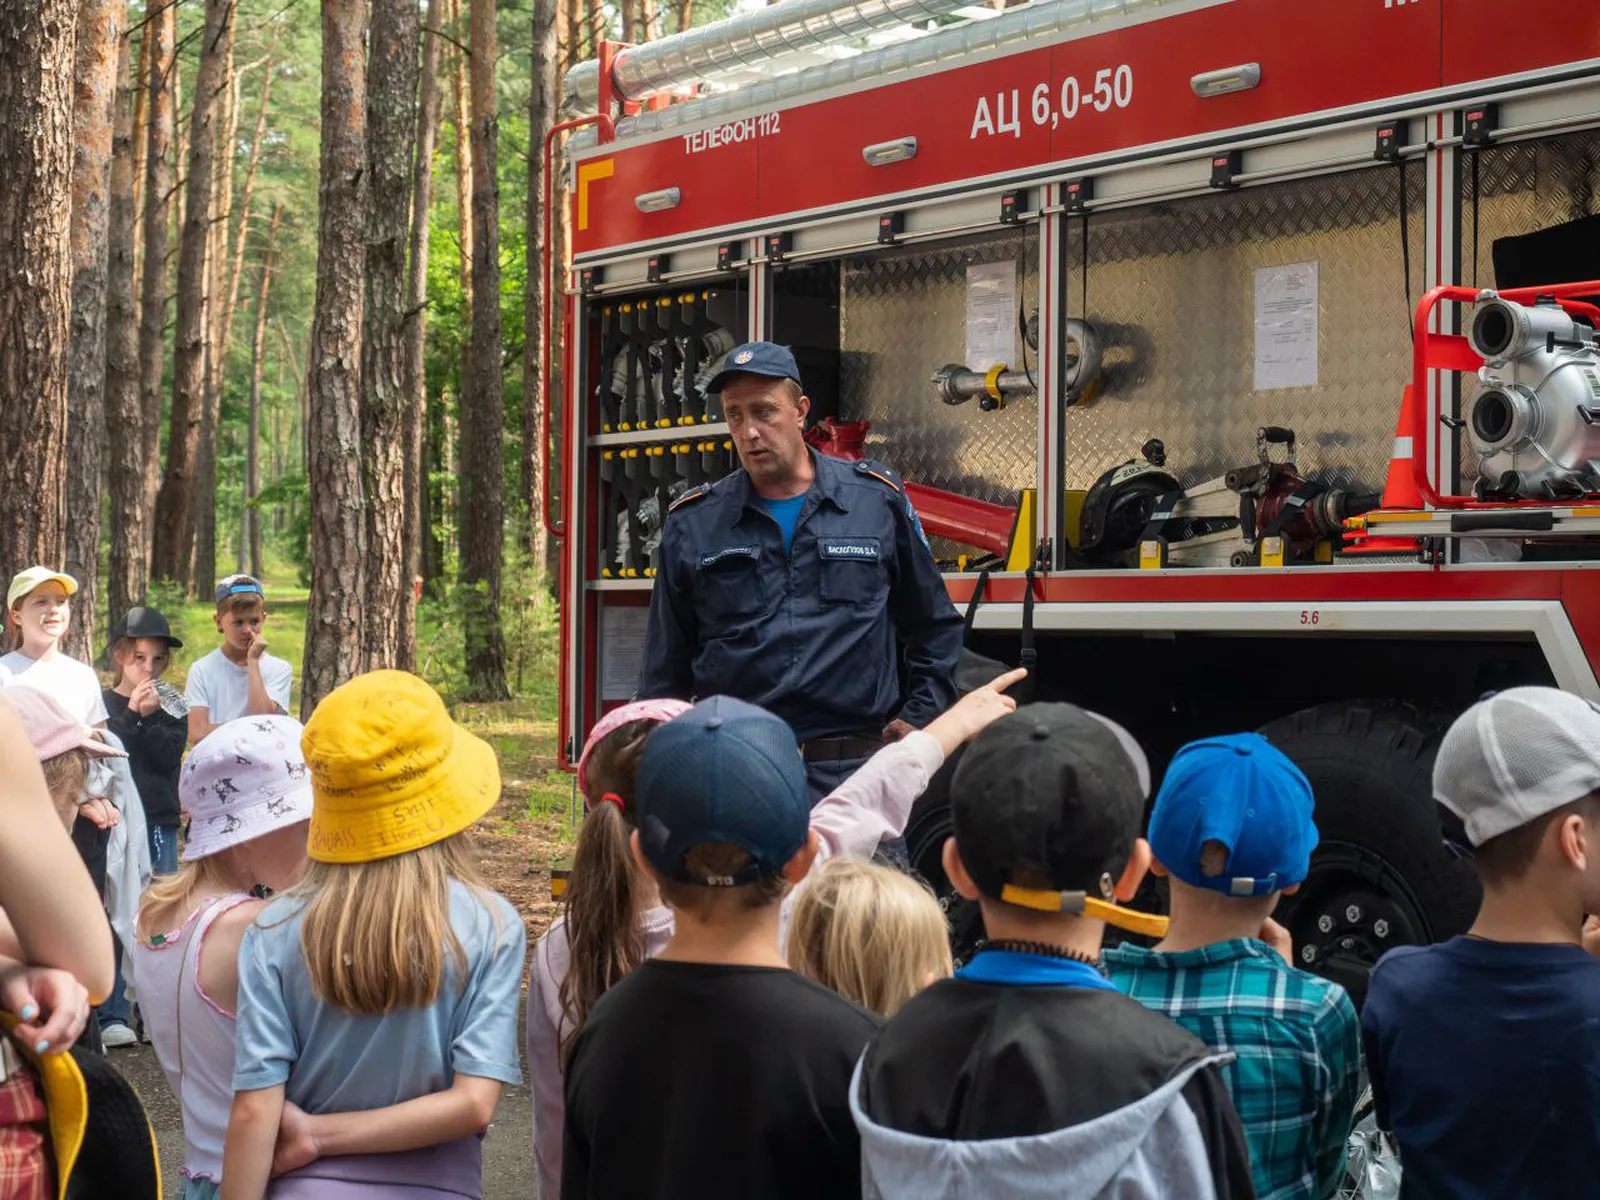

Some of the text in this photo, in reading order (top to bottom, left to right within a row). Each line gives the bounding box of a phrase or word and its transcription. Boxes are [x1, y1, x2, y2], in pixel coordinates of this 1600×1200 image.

[970, 64, 1133, 139] АЦ 6,0-50
[683, 112, 780, 154] ТЕЛЕФОН 112
[1300, 610, 1319, 624] 5.6
